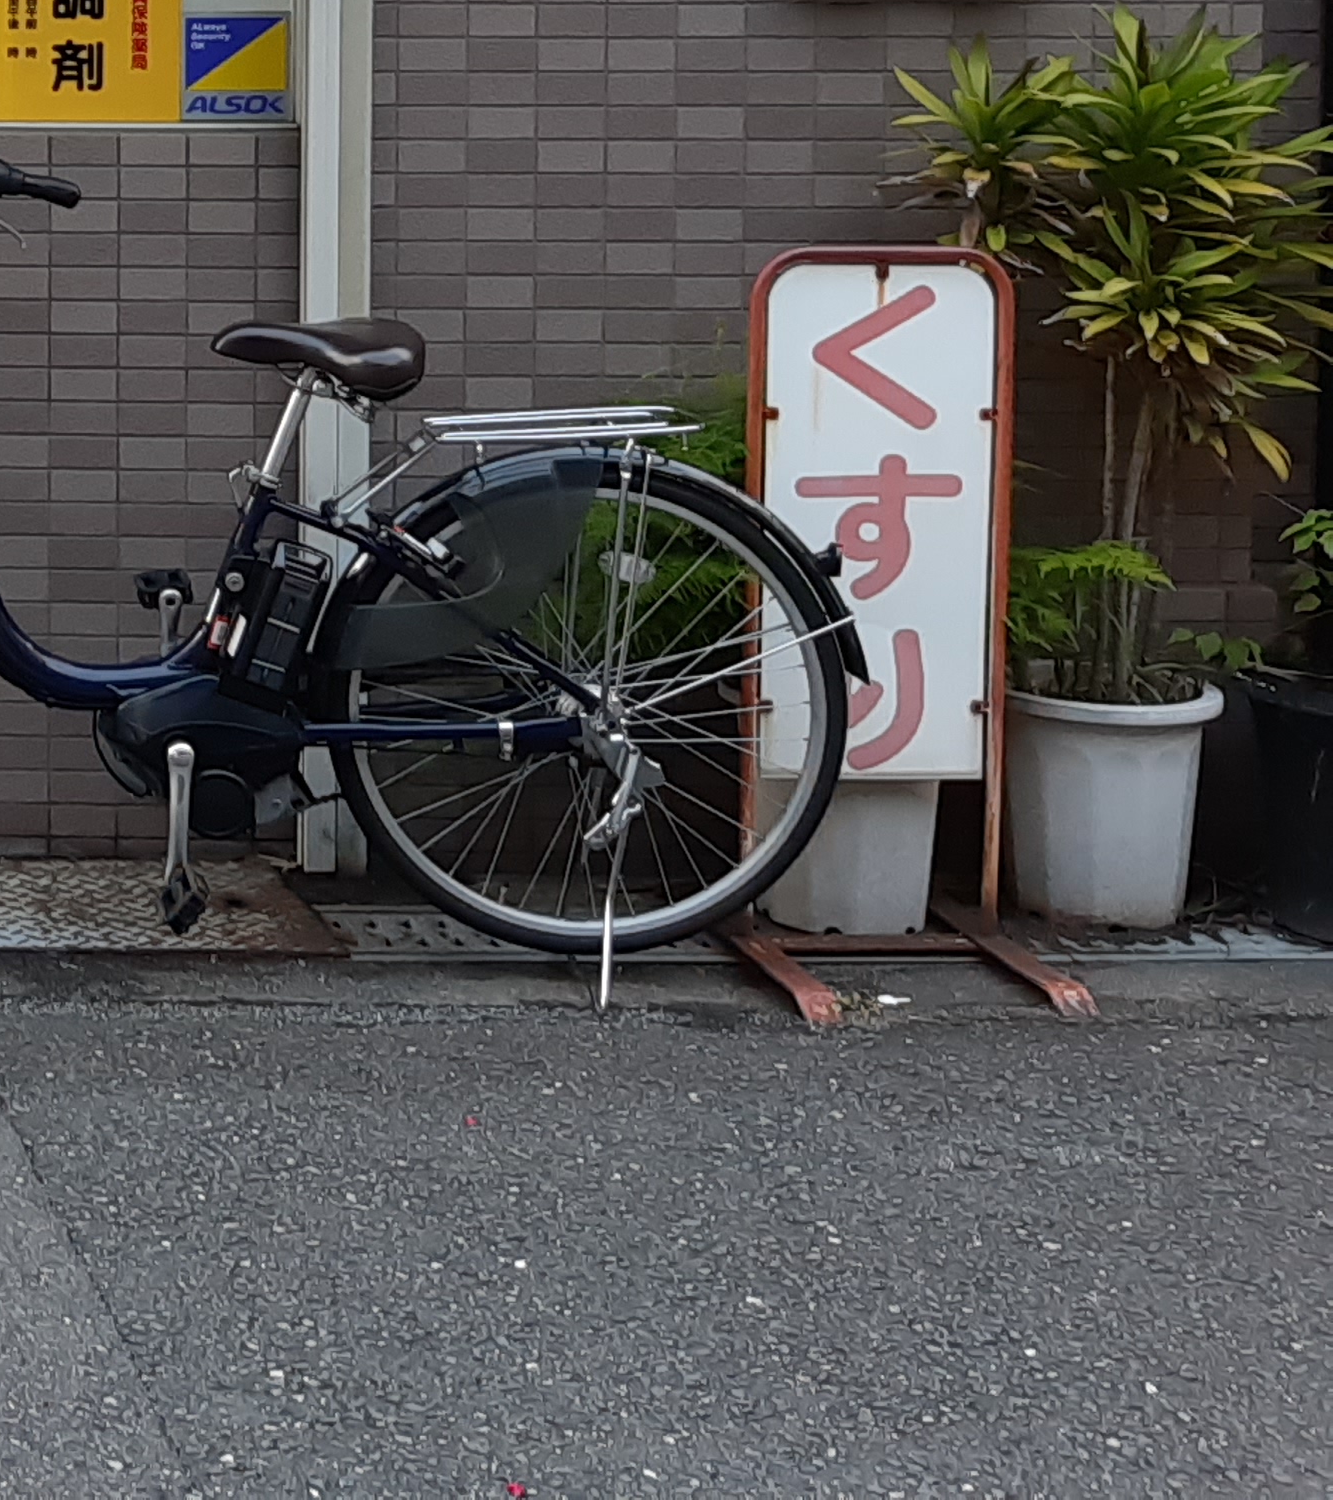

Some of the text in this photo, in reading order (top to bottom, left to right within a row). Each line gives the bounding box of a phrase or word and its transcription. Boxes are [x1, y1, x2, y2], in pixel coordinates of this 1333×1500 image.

[185, 95, 285, 115] ALSOK
[794, 284, 963, 770] くすり
